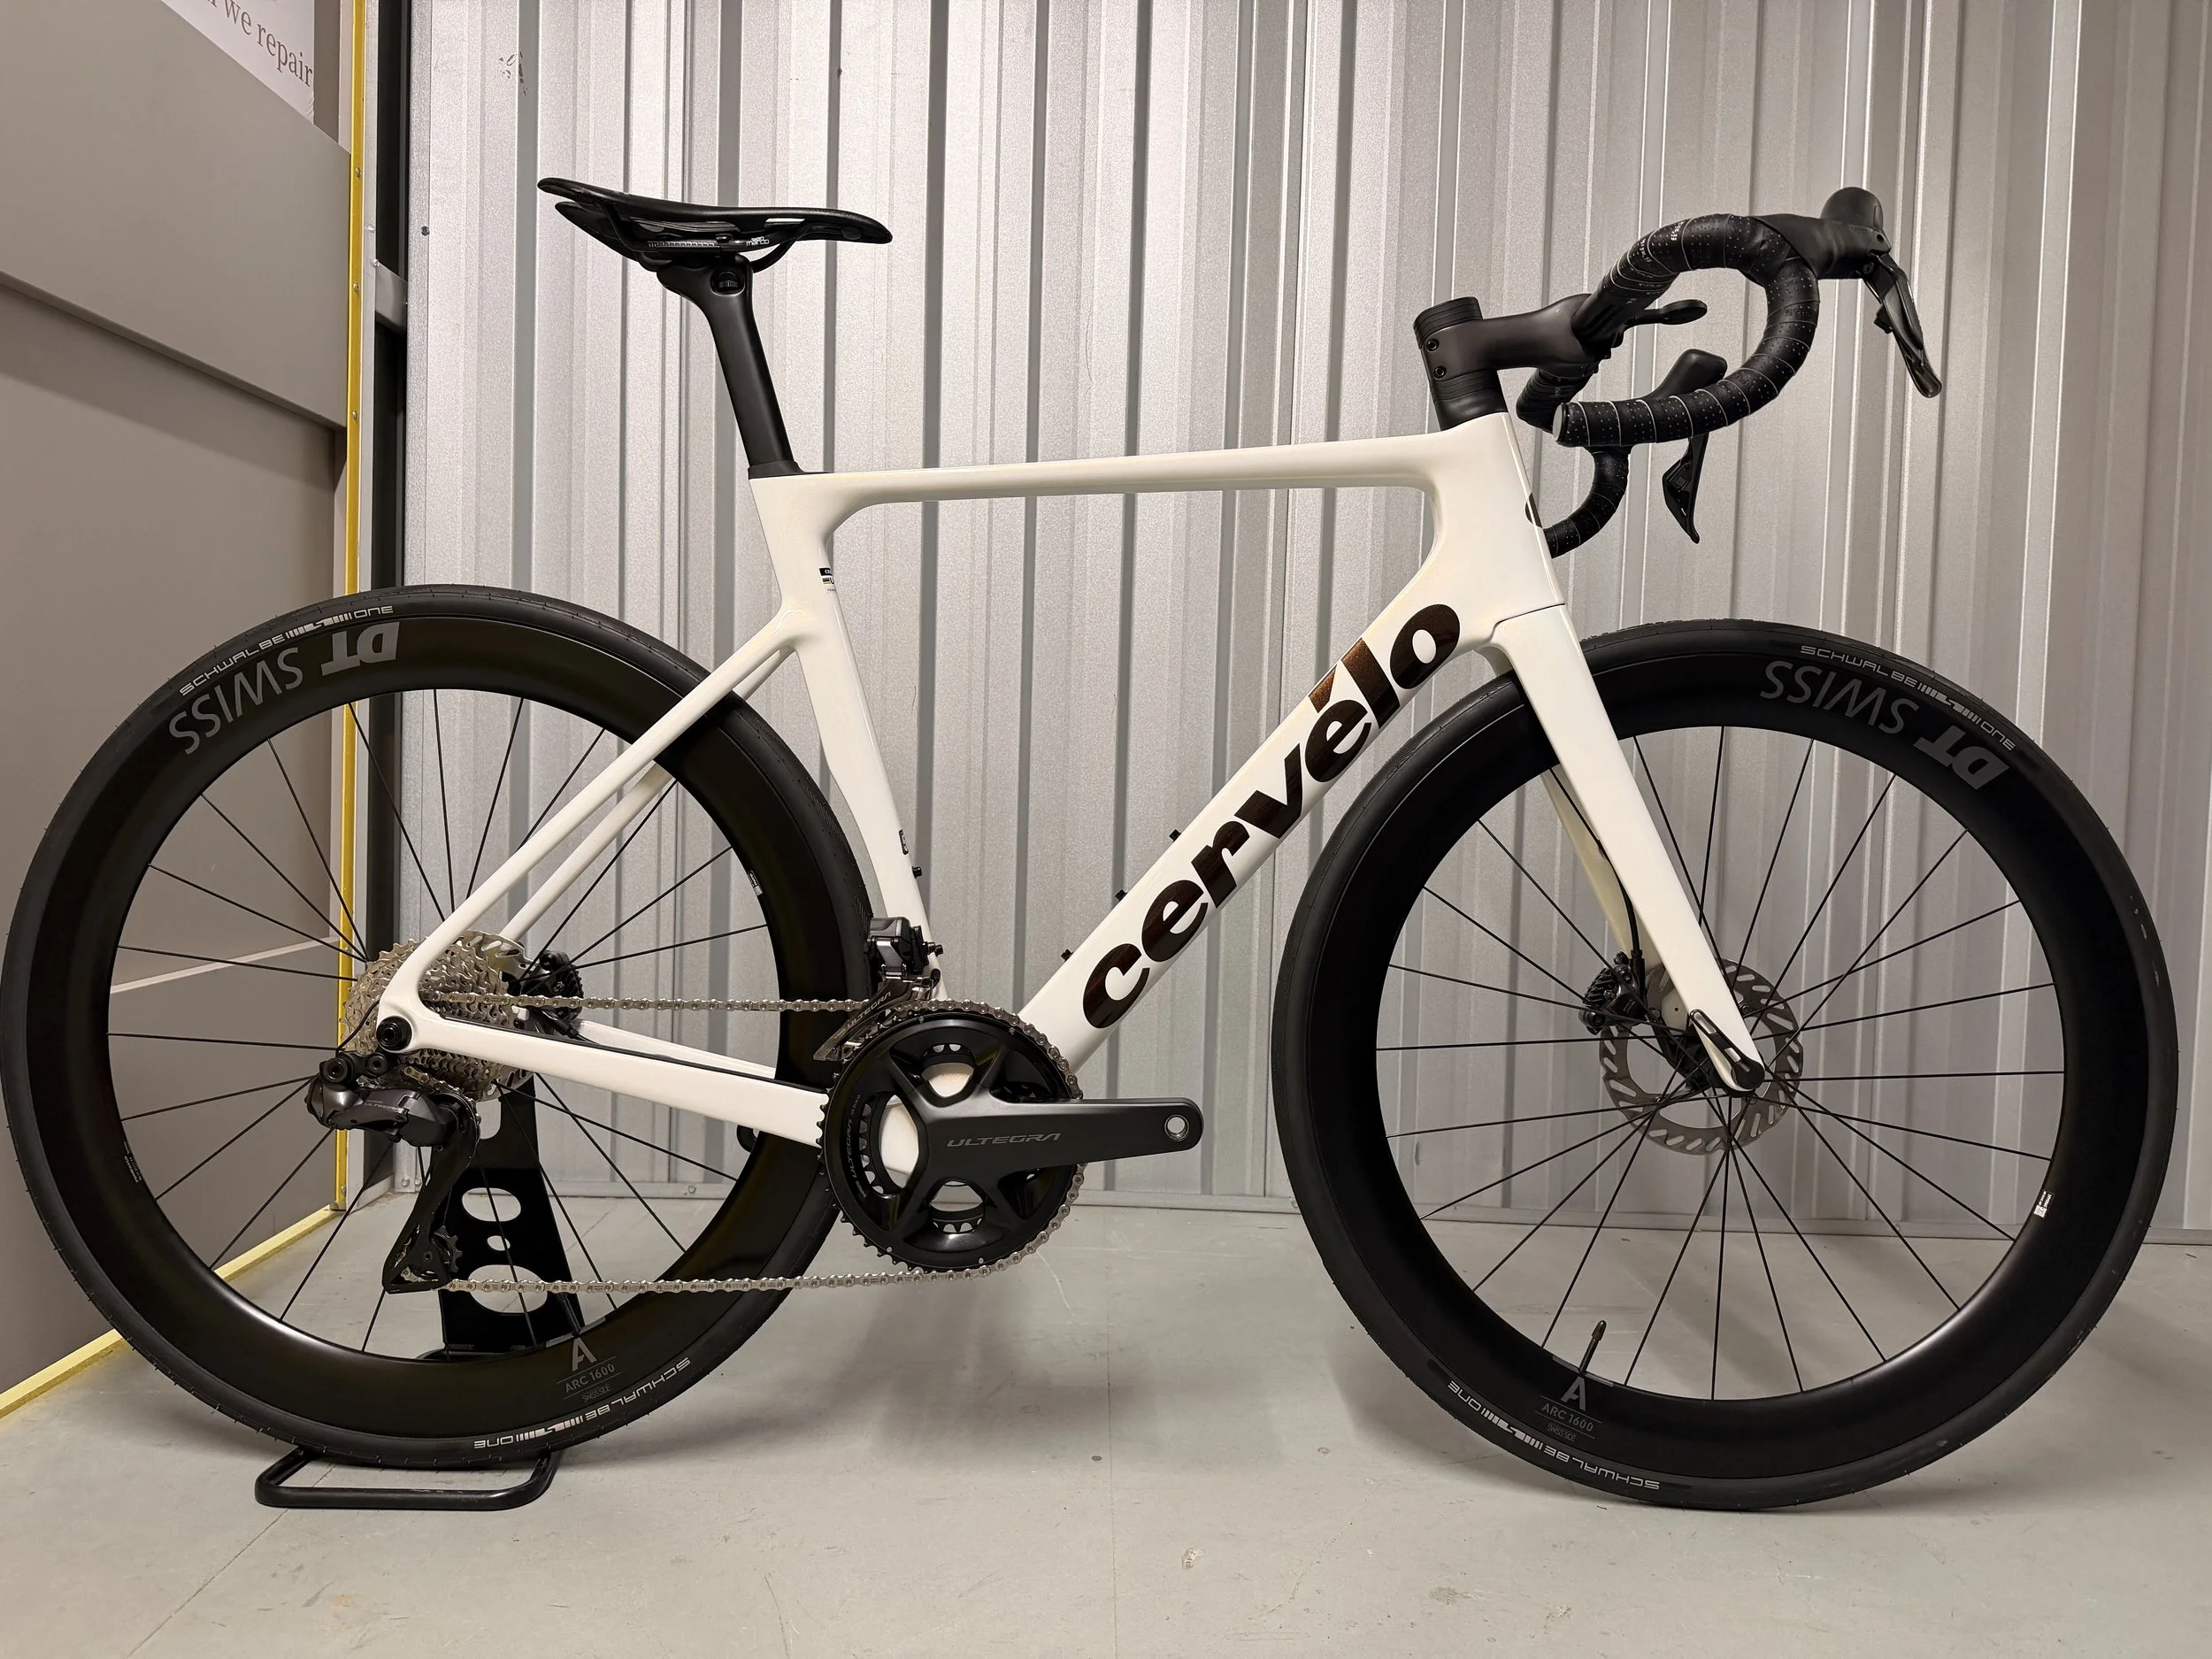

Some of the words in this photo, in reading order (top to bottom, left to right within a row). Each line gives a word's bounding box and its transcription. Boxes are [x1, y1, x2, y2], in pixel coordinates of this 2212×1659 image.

[224, 0, 252, 35] we
[257, 23, 312, 88] repair
[180, 634, 285, 696] SCHWALBE
[354, 605, 394, 619] ONE
[320, 621, 400, 676] DT
[168, 647, 303, 755] SWISS
[1760, 660, 1920, 734] SWISS
[1801, 645, 1917, 688] SCHWALBE
[1980, 720, 2016, 751] ONE
[1913, 725, 2010, 790] DT
[1083, 603, 1461, 1029] cervélo
[947, 1133, 1061, 1148] ULTEGRA
[566, 1376, 589, 1393] ARC
[588, 1363, 615, 1381] 1600
[585, 1356, 691, 1421] SCHWALBE
[1448, 1380, 1482, 1412] ONE
[473, 1435, 514, 1449] ONE
[1541, 1402, 1567, 1419] ARC
[1569, 1414, 1594, 1432] 1600
[1543, 1445, 1660, 1490] SCHWALBE
